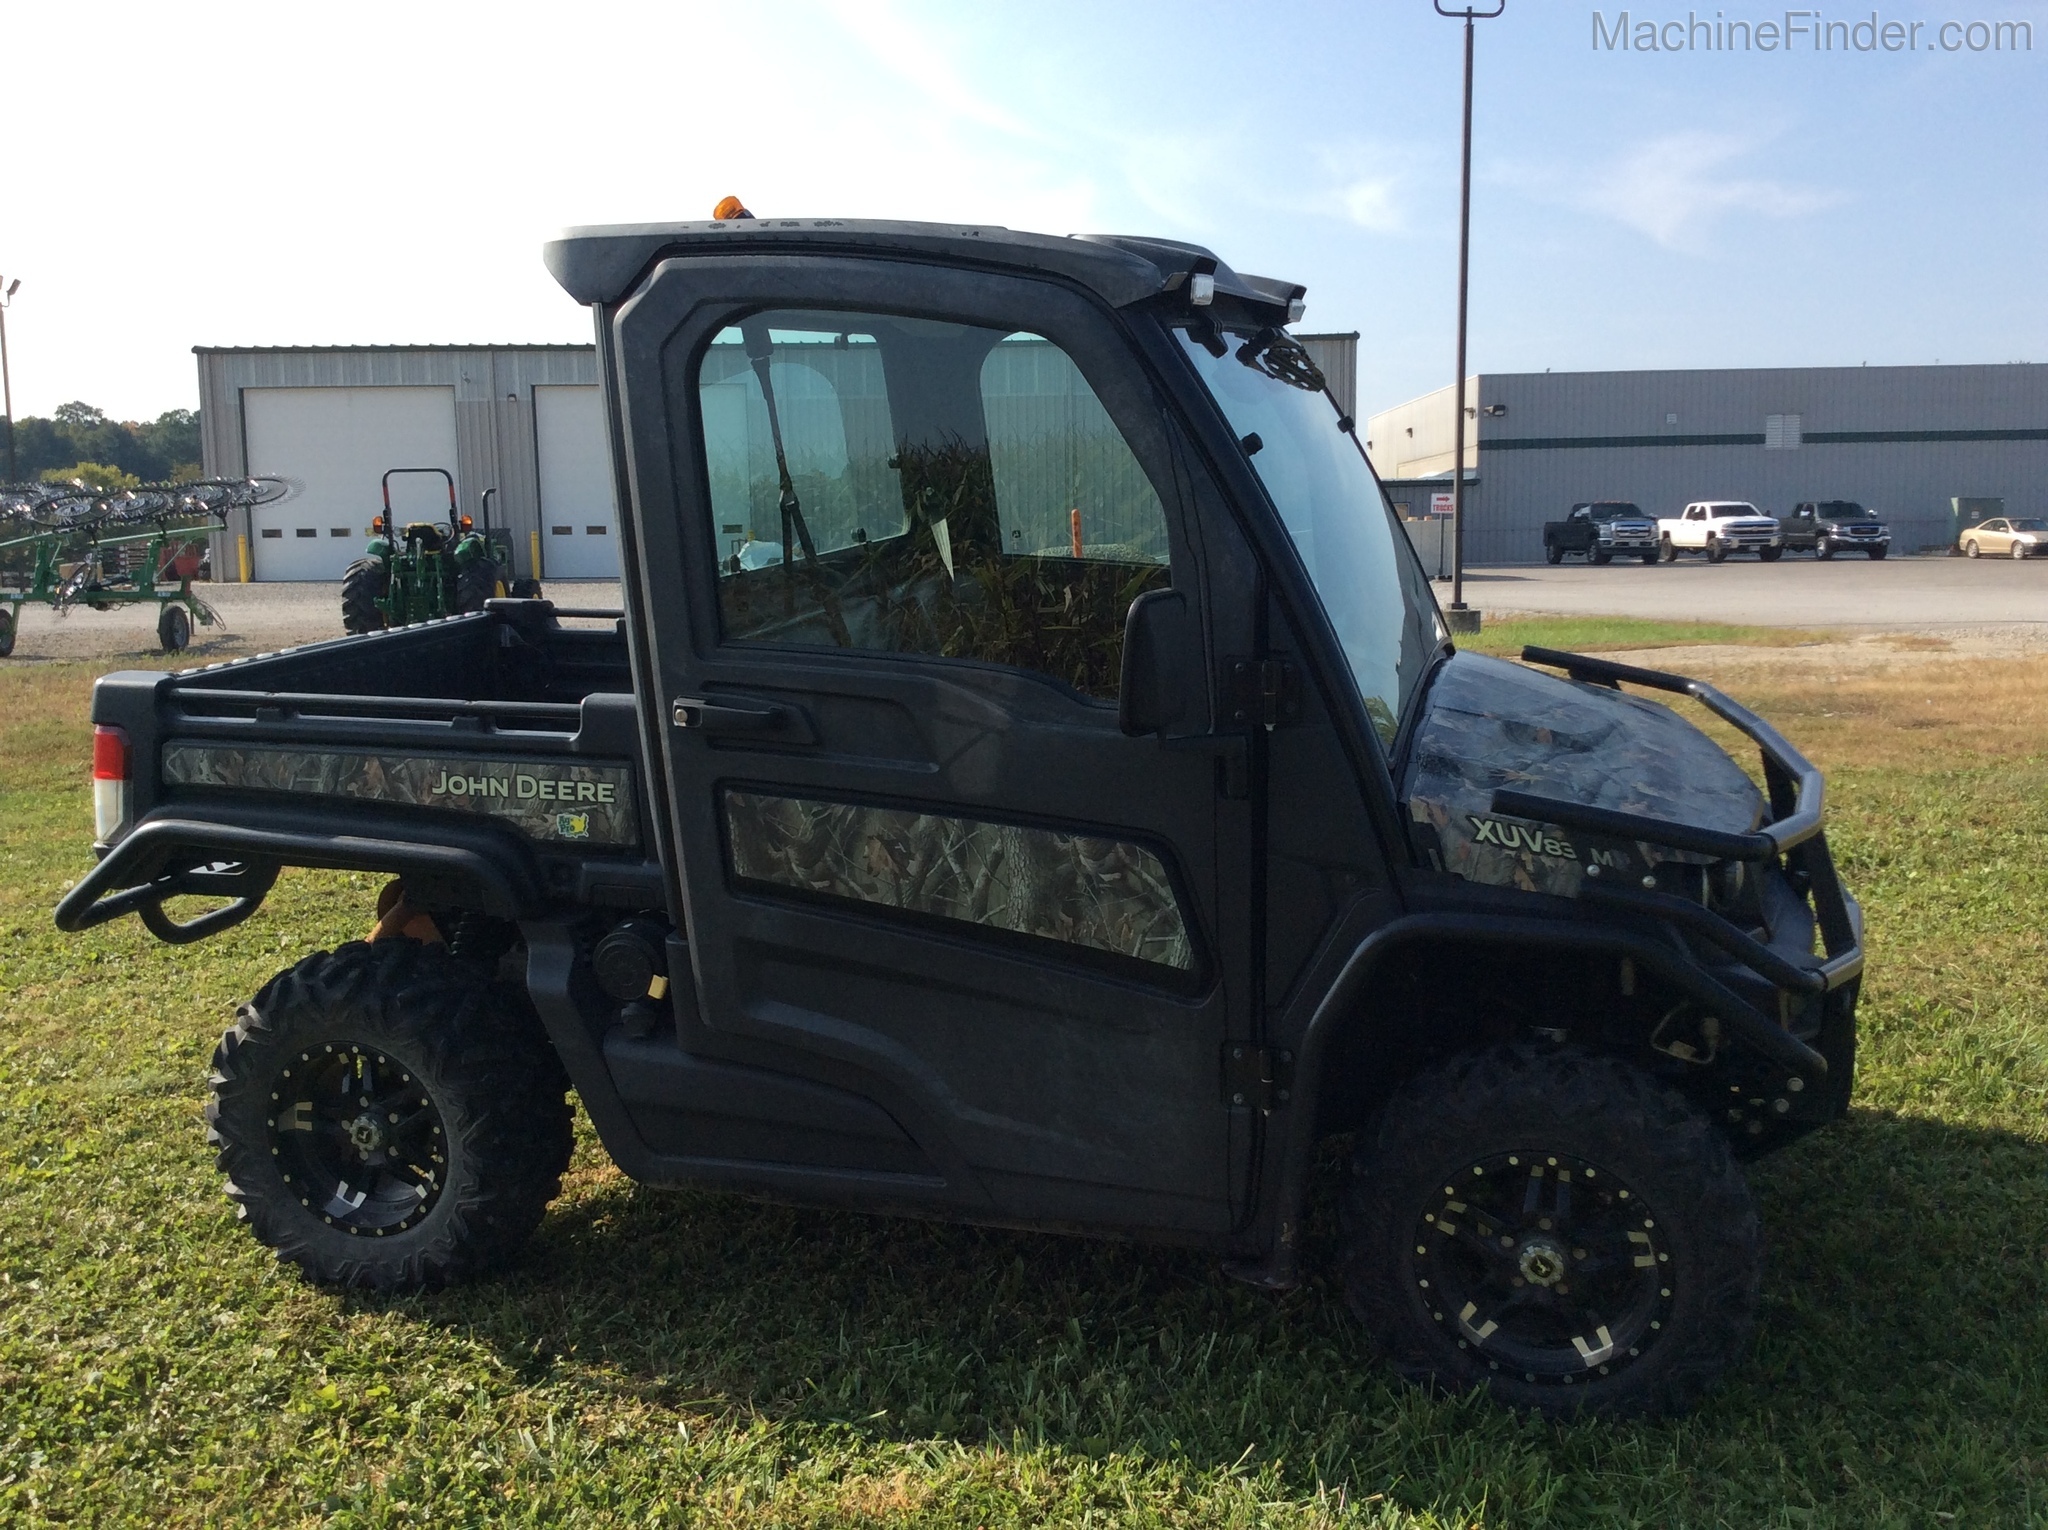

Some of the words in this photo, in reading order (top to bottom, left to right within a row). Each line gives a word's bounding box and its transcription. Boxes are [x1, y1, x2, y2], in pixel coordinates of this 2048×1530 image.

[1433, 504, 1454, 512] TRUCKS
[432, 770, 509, 798] JOHN
[516, 775, 615, 803] DEERE
